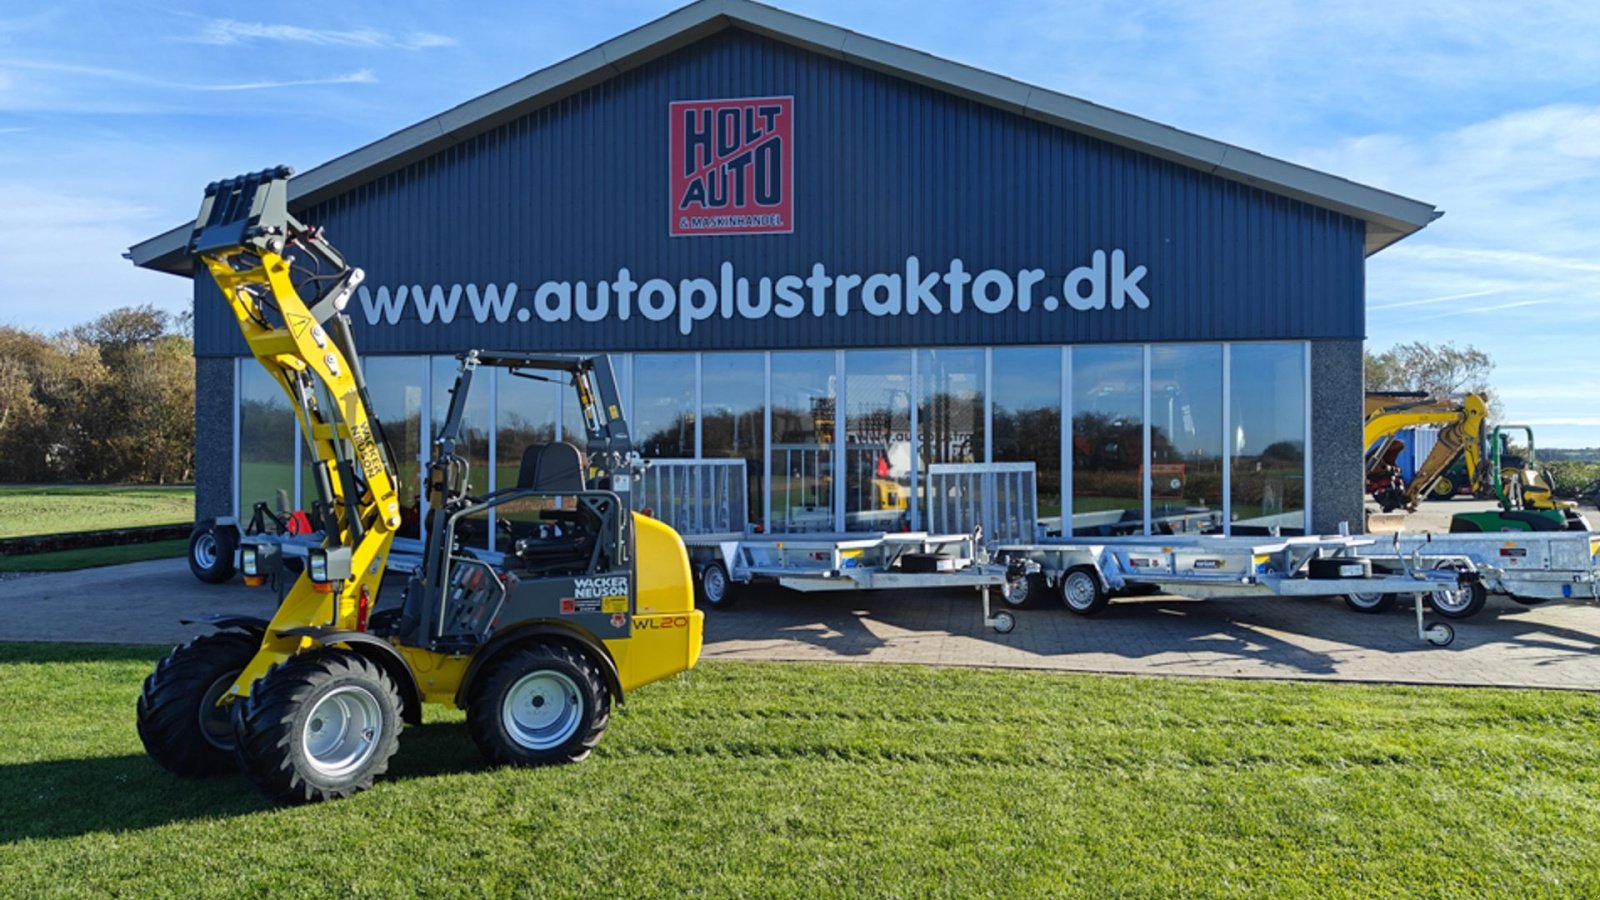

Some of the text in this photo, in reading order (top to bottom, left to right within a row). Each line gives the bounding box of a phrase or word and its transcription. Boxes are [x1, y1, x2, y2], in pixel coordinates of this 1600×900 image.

[684, 105, 783, 179] HOLT
[679, 136, 783, 210] AUTO
[679, 214, 784, 229] & MASKINHANDEL
[357, 248, 1150, 335] www.autoplustraktor.dk
[574, 576, 628, 589] WACKER
[575, 586, 628, 598] NEUSON
[633, 616, 688, 630] WL20
